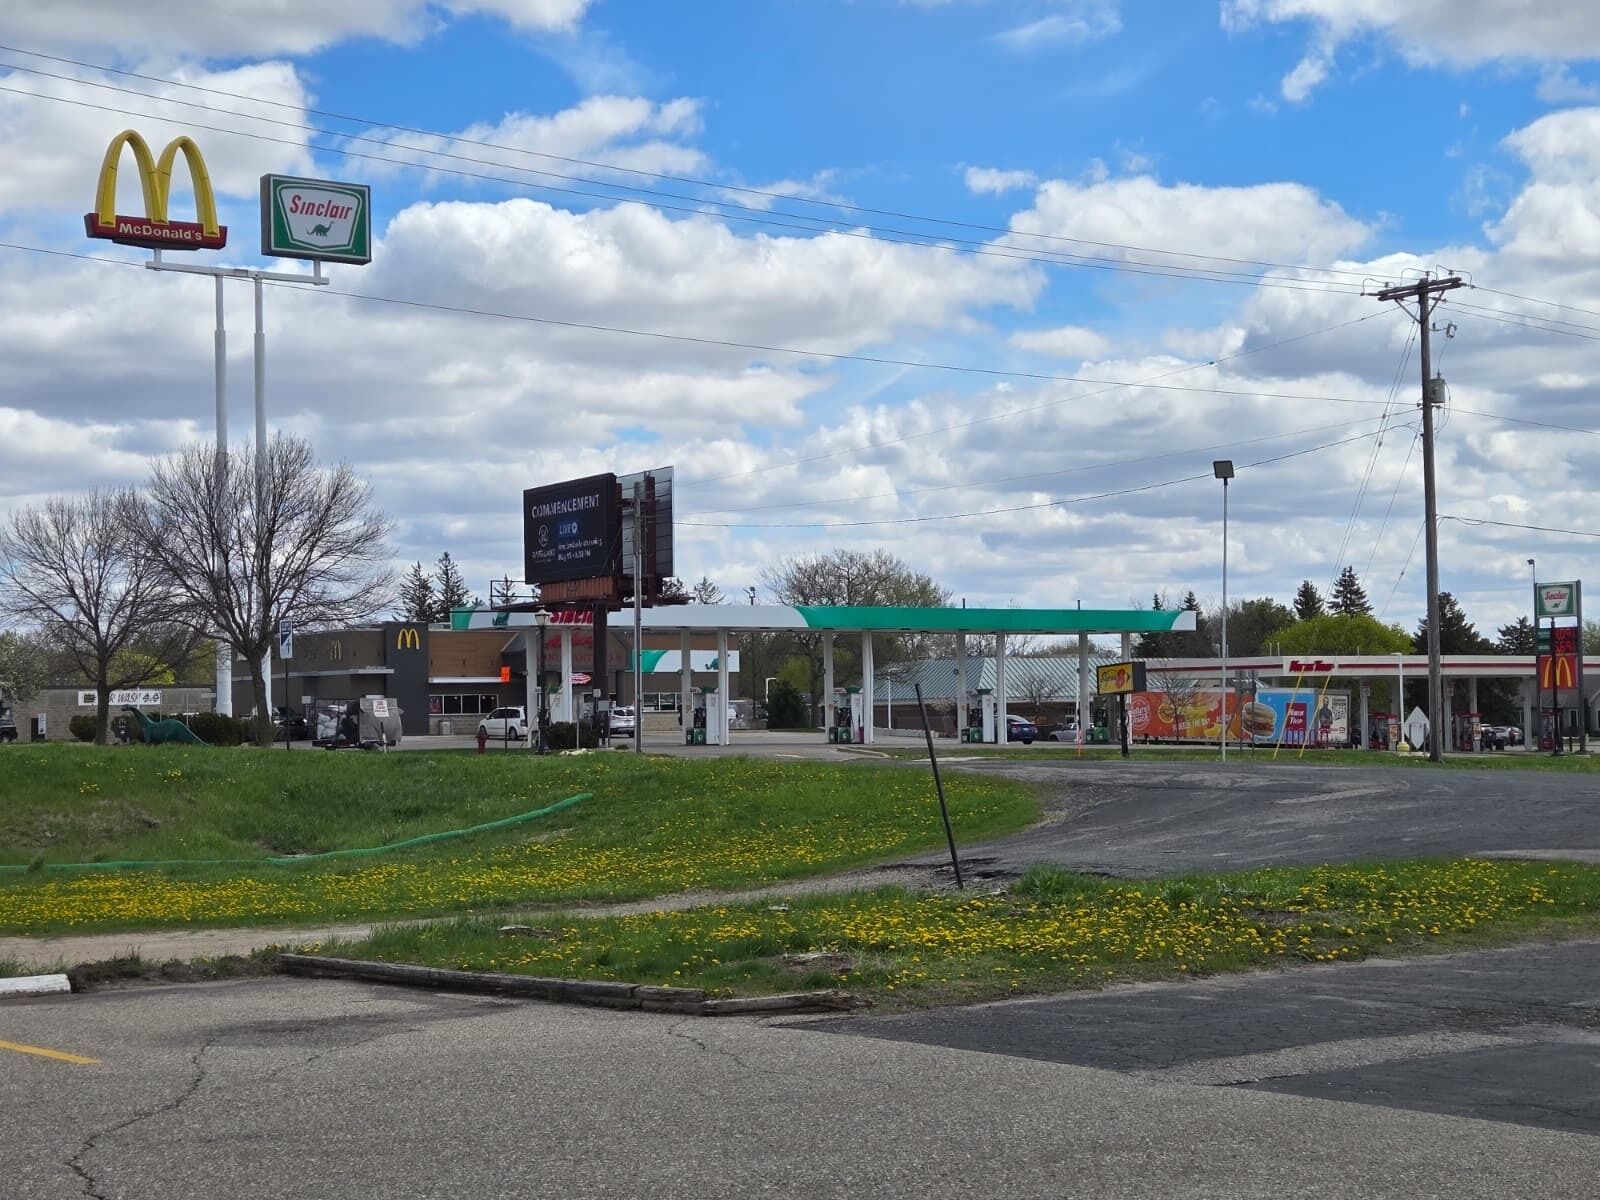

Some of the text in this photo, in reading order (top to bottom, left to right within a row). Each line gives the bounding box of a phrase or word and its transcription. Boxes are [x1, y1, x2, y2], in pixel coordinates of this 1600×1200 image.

[289, 194, 354, 220] Sinclair
[118, 222, 203, 242] McDonald's
[531, 494, 600, 519] COMMENCEMENT
